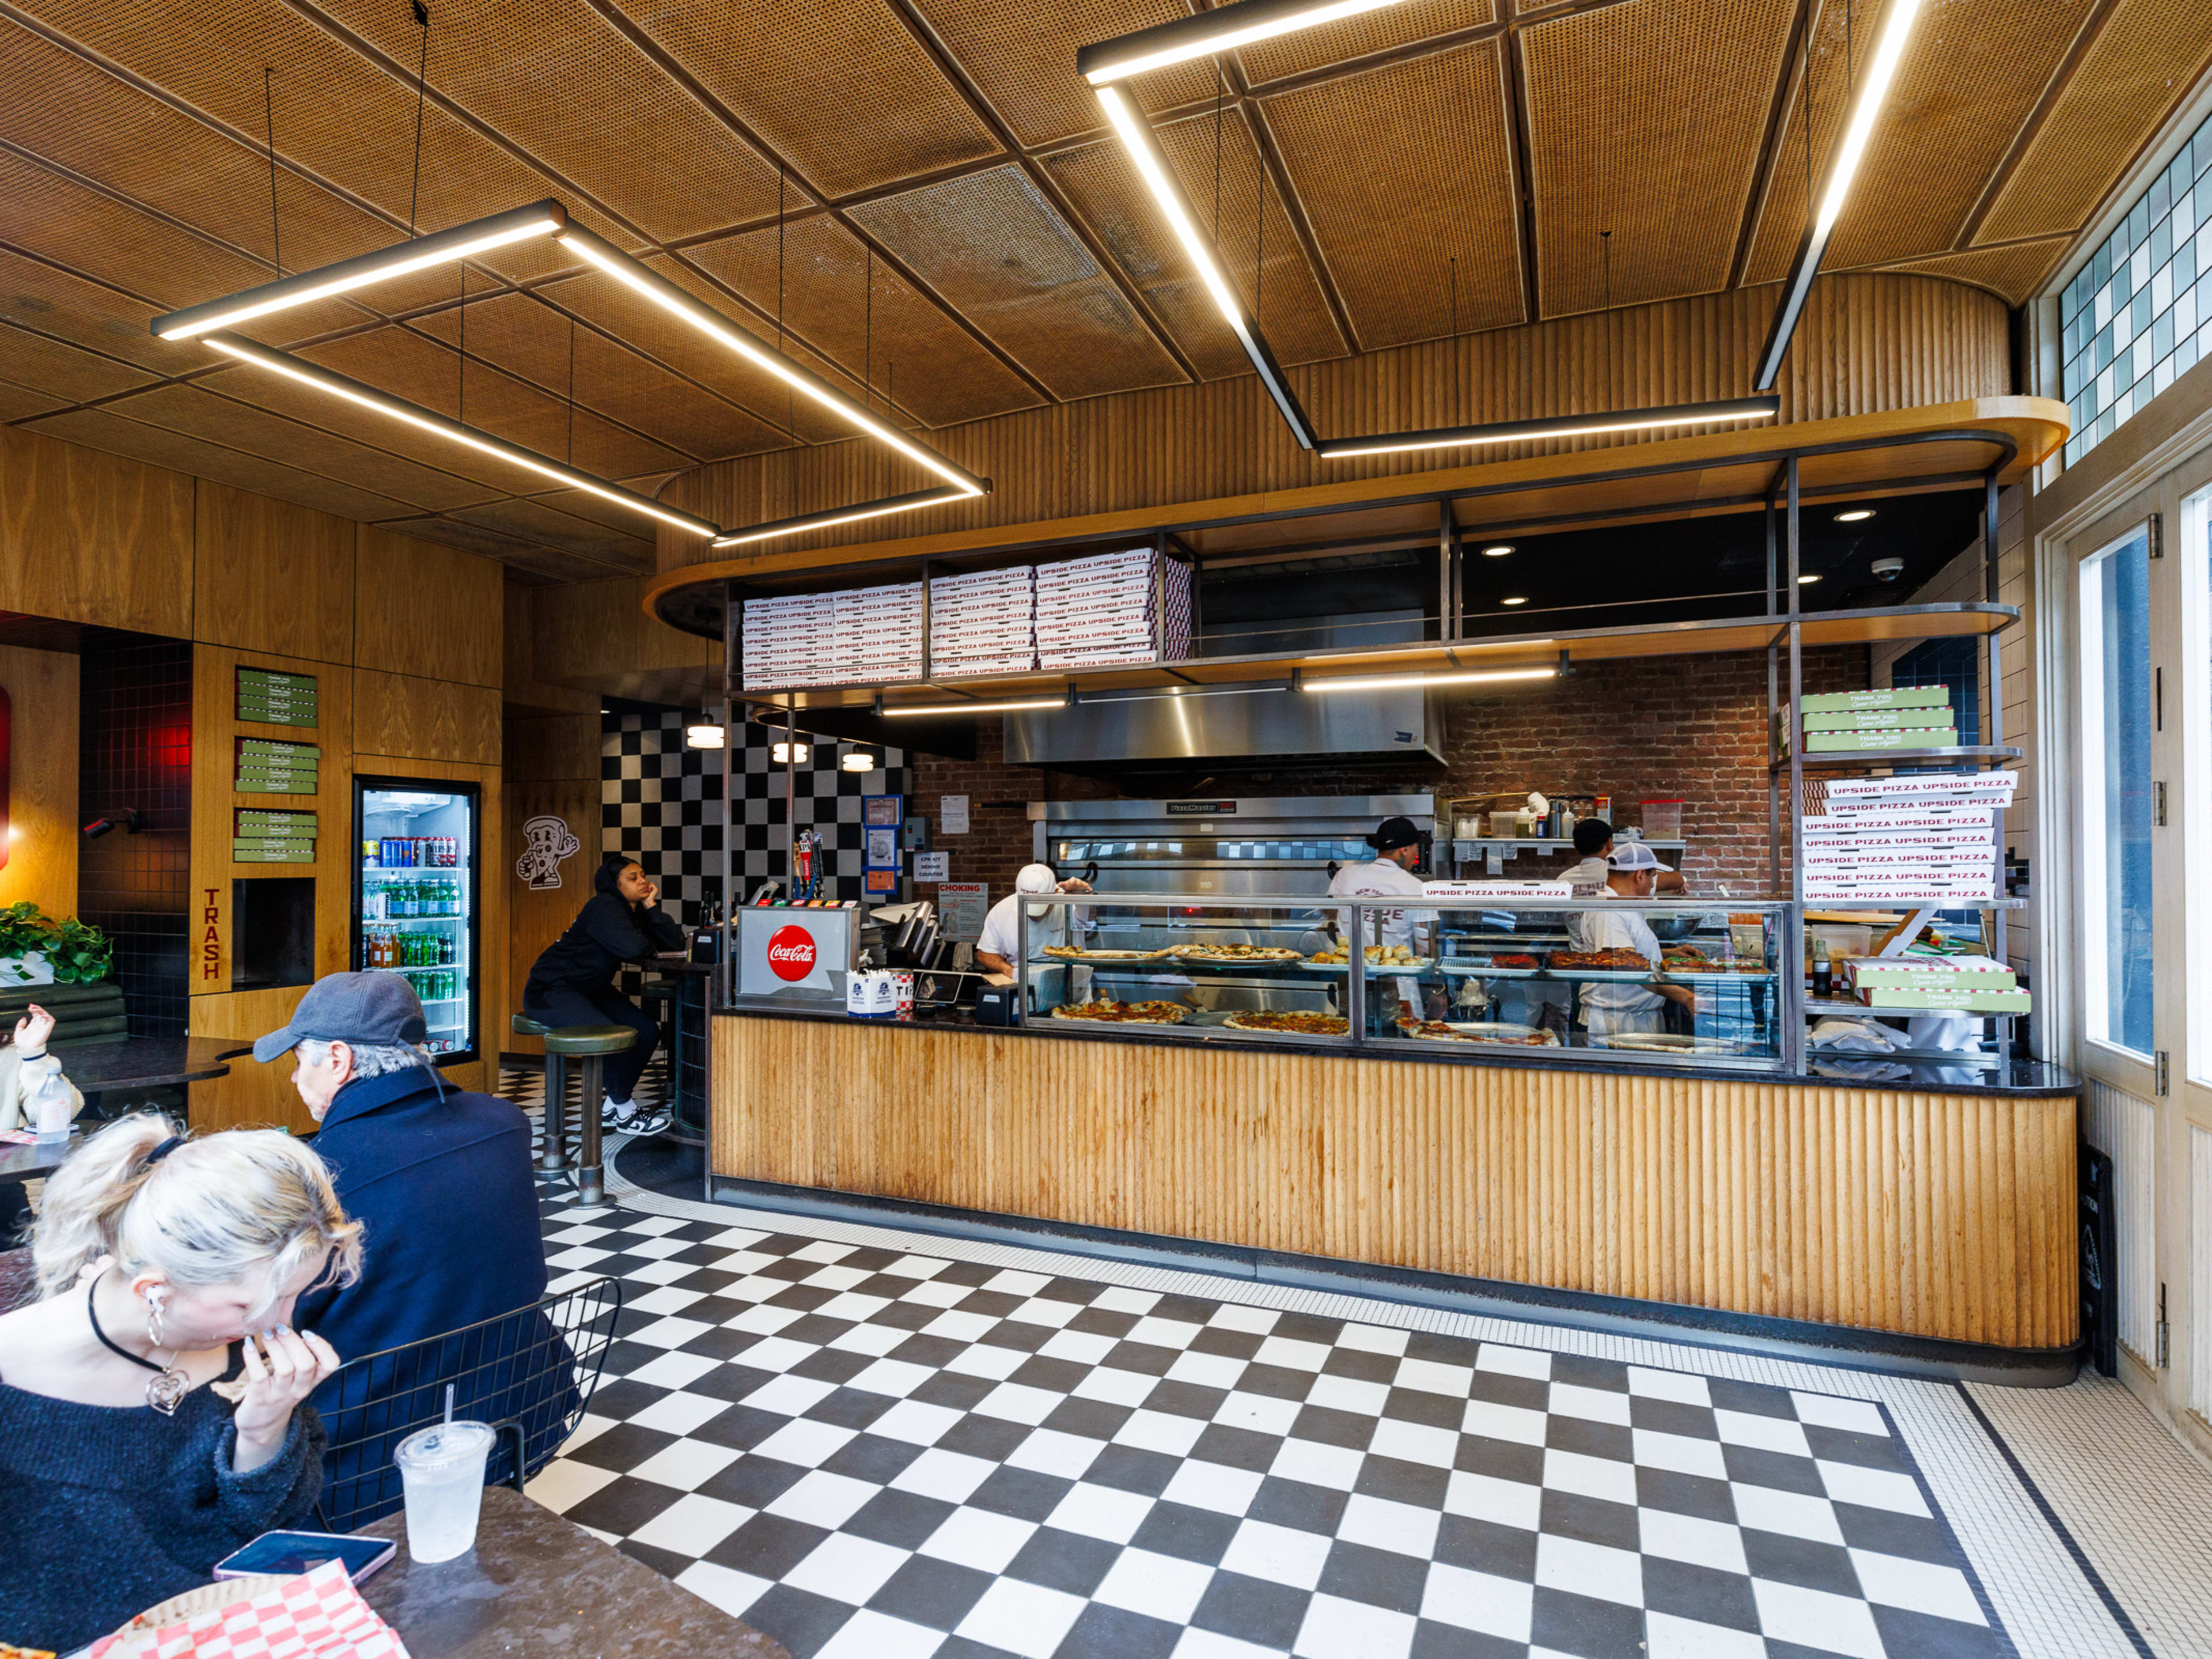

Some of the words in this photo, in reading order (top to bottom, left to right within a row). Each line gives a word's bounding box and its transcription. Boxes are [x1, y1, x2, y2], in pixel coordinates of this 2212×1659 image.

[1041, 566, 1068, 575] UPSIDE
[1094, 558, 1122, 567] UPSIDE
[1124, 554, 1147, 562] PIZZA
[1039, 580, 1066, 589] UPSIDE
[1067, 577, 1089, 585] PIZZA
[1091, 572, 1119, 581] UPSIDE
[1122, 569, 1144, 577] PIZZA
[1040, 594, 1067, 603] UPSIDE
[1092, 587, 1120, 595] UPSIDE
[1091, 601, 1119, 609] UPSIDE
[1093, 643, 1122, 651] UPSIDE
[204, 889, 219, 979] TRASH
[770, 944, 816, 961] Coca-Cola
